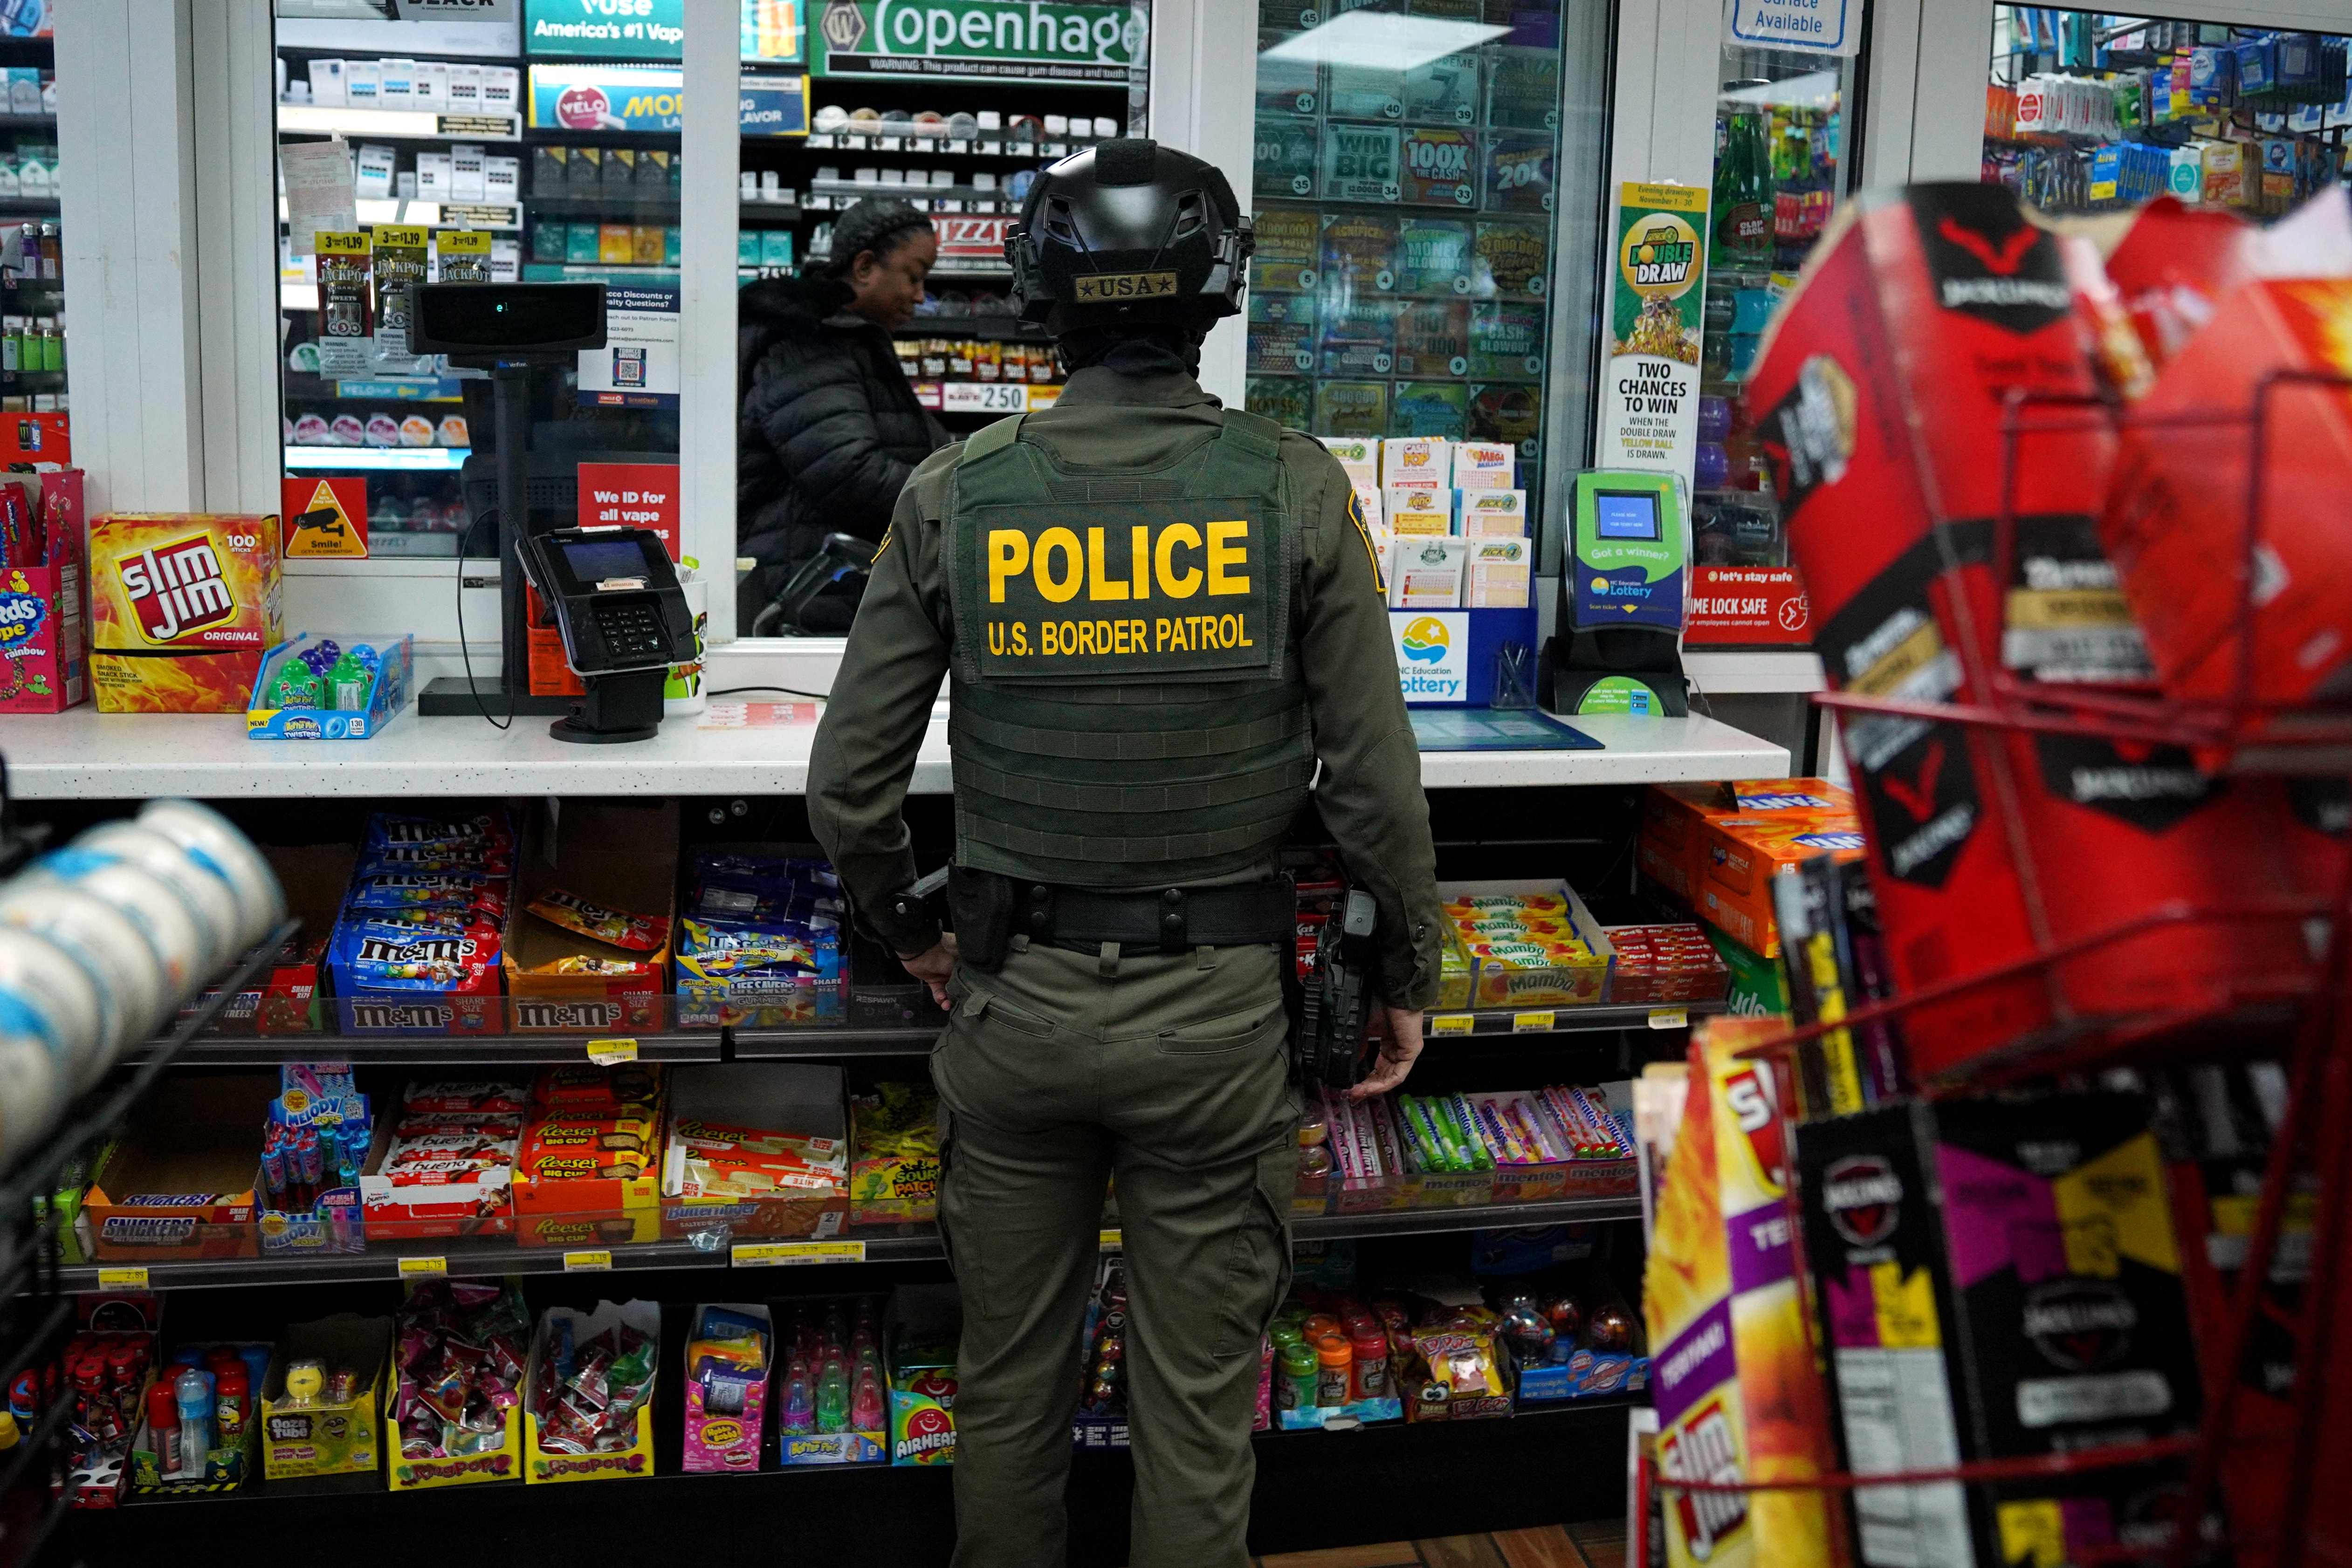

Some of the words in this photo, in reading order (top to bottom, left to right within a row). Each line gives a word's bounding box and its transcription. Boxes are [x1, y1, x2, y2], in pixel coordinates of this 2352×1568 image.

[1756, 10, 1822, 34] Available
[534, 19, 620, 39] America's
[624, 22, 643, 40] #1
[870, 59, 921, 71] WARNING:
[923, 60, 942, 72] This
[942, 62, 978, 74] product
[979, 64, 997, 74] can
[998, 66, 1026, 75] cause
[1027, 67, 1048, 77] gum
[1049, 66, 1083, 77] disease
[1084, 67, 1101, 78] and
[561, 99, 605, 114] VELO
[1298, 98, 1312, 108] 41
[1386, 104, 1399, 113] 40
[1457, 110, 1471, 119] 39
[1336, 135, 1392, 153] WIN
[1408, 142, 1468, 170] 100X
[1334, 156, 1391, 180] BIG
[1432, 168, 1461, 181] CASH
[1294, 180, 1309, 190] 35
[1384, 186, 1398, 196] 34
[1638, 185, 1664, 196] Evening
[1665, 188, 1695, 198] drawings
[1456, 189, 1471, 199] 33
[1639, 196, 1672, 205] November
[326, 236, 332, 248] 3
[343, 236, 363, 249] $1.19
[383, 231, 389, 244] 3
[400, 232, 420, 245] $1.19
[453, 236, 457, 246] 3
[464, 236, 478, 246] $1.19
[1407, 242, 1462, 258] MONEY
[318, 267, 371, 283] JACKPOT
[374, 260, 426, 277] JACKPOT
[440, 267, 490, 283] JACKPOT
[1637, 262, 1688, 283] DRAW
[1099, 275, 1153, 298] USA
[624, 291, 663, 300] Discounts
[625, 300, 668, 308] Questions?
[1637, 362, 1671, 378] TWO
[1619, 379, 1687, 397] CHANCES
[1624, 397, 1643, 412] TO
[1648, 398, 1678, 414] WIN
[1629, 417, 1653, 426] WHEN
[1655, 418, 1669, 427] THE
[1620, 427, 1651, 437] DOUBLE
[1653, 429, 1677, 438] DRAW
[1403, 443, 1430, 454] CASH
[1620, 438, 1652, 448] YELLOW
[1655, 439, 1673, 449] BALL
[1403, 453, 1430, 467] POP
[1479, 450, 1505, 462] MEGA
[1627, 449, 1634, 458] IS
[1636, 450, 1668, 459] DRAWN.
[593, 491, 619, 503] We
[622, 492, 639, 503] ID
[642, 491, 666, 504] for
[1407, 496, 1432, 508] Keno
[1476, 499, 1502, 508] PICK
[599, 508, 619, 521] all
[621, 511, 660, 523] vape
[226, 535, 255, 548] 100
[1479, 548, 1506, 557] PICK
[1591, 548, 1612, 559] Got
[1626, 547, 1670, 561] winner?
[988, 520, 1251, 603] POLICE
[122, 545, 222, 602] slim
[1719, 571, 1743, 582] let's
[1744, 571, 1768, 583] stay
[1769, 571, 1793, 582] safe
[1610, 586, 1652, 599] Lottery
[151, 576, 234, 639] jim
[1690, 598, 1709, 615] IME
[1711, 598, 1740, 615] LOCK
[1741, 598, 1768, 615] SAFE
[203, 631, 260, 641] ORIGINAL
[988, 622, 1033, 657] U.S.
[1041, 619, 1148, 656] BORDER
[1156, 612, 1253, 653] PATROL
[4, 646, 46, 660] rainbow
[1412, 666, 1451, 675] Education
[283, 731, 322, 739] TWISTERS
[1781, 863, 1795, 874] 15
[1471, 896, 1527, 910] Mamba
[1473, 919, 1529, 933] Mamba
[1488, 941, 1547, 956] Mamba
[754, 981, 797, 996] SAVERS
[813, 978, 842, 986] SHARE
[1507, 972, 1576, 994] Mamba
[629, 999, 648, 1008] SIZE
[736, 995, 788, 1007] GUMMIES
[224, 1009, 252, 1018] TREES
[461, 1005, 482, 1013] SIZE
[287, 1097, 343, 1127] MELODY
[1572, 1088, 1599, 1129] mentos
[313, 1115, 344, 1124] POPS
[1455, 1096, 1473, 1136] mentos
[535, 1123, 600, 1138] Reese's
[679, 1120, 749, 1143] Reese's
[422, 1134, 475, 1147] bueno
[412, 1159, 466, 1171] bueno
[533, 1155, 600, 1169] Reese's
[894, 1170, 937, 1184] SOUR
[1499, 1171, 1565, 1183] mentos
[1571, 1168, 1637, 1179] mentos
[1424, 1178, 1491, 1189] mentos
[123, 1194, 213, 1206] SNICKERS
[367, 1195, 390, 1205] bueno
[103, 1218, 194, 1236] SNICKERS
[534, 1220, 597, 1234] Reese's
[270, 1418, 308, 1430] Ooze
[273, 1428, 308, 1440] Tube
